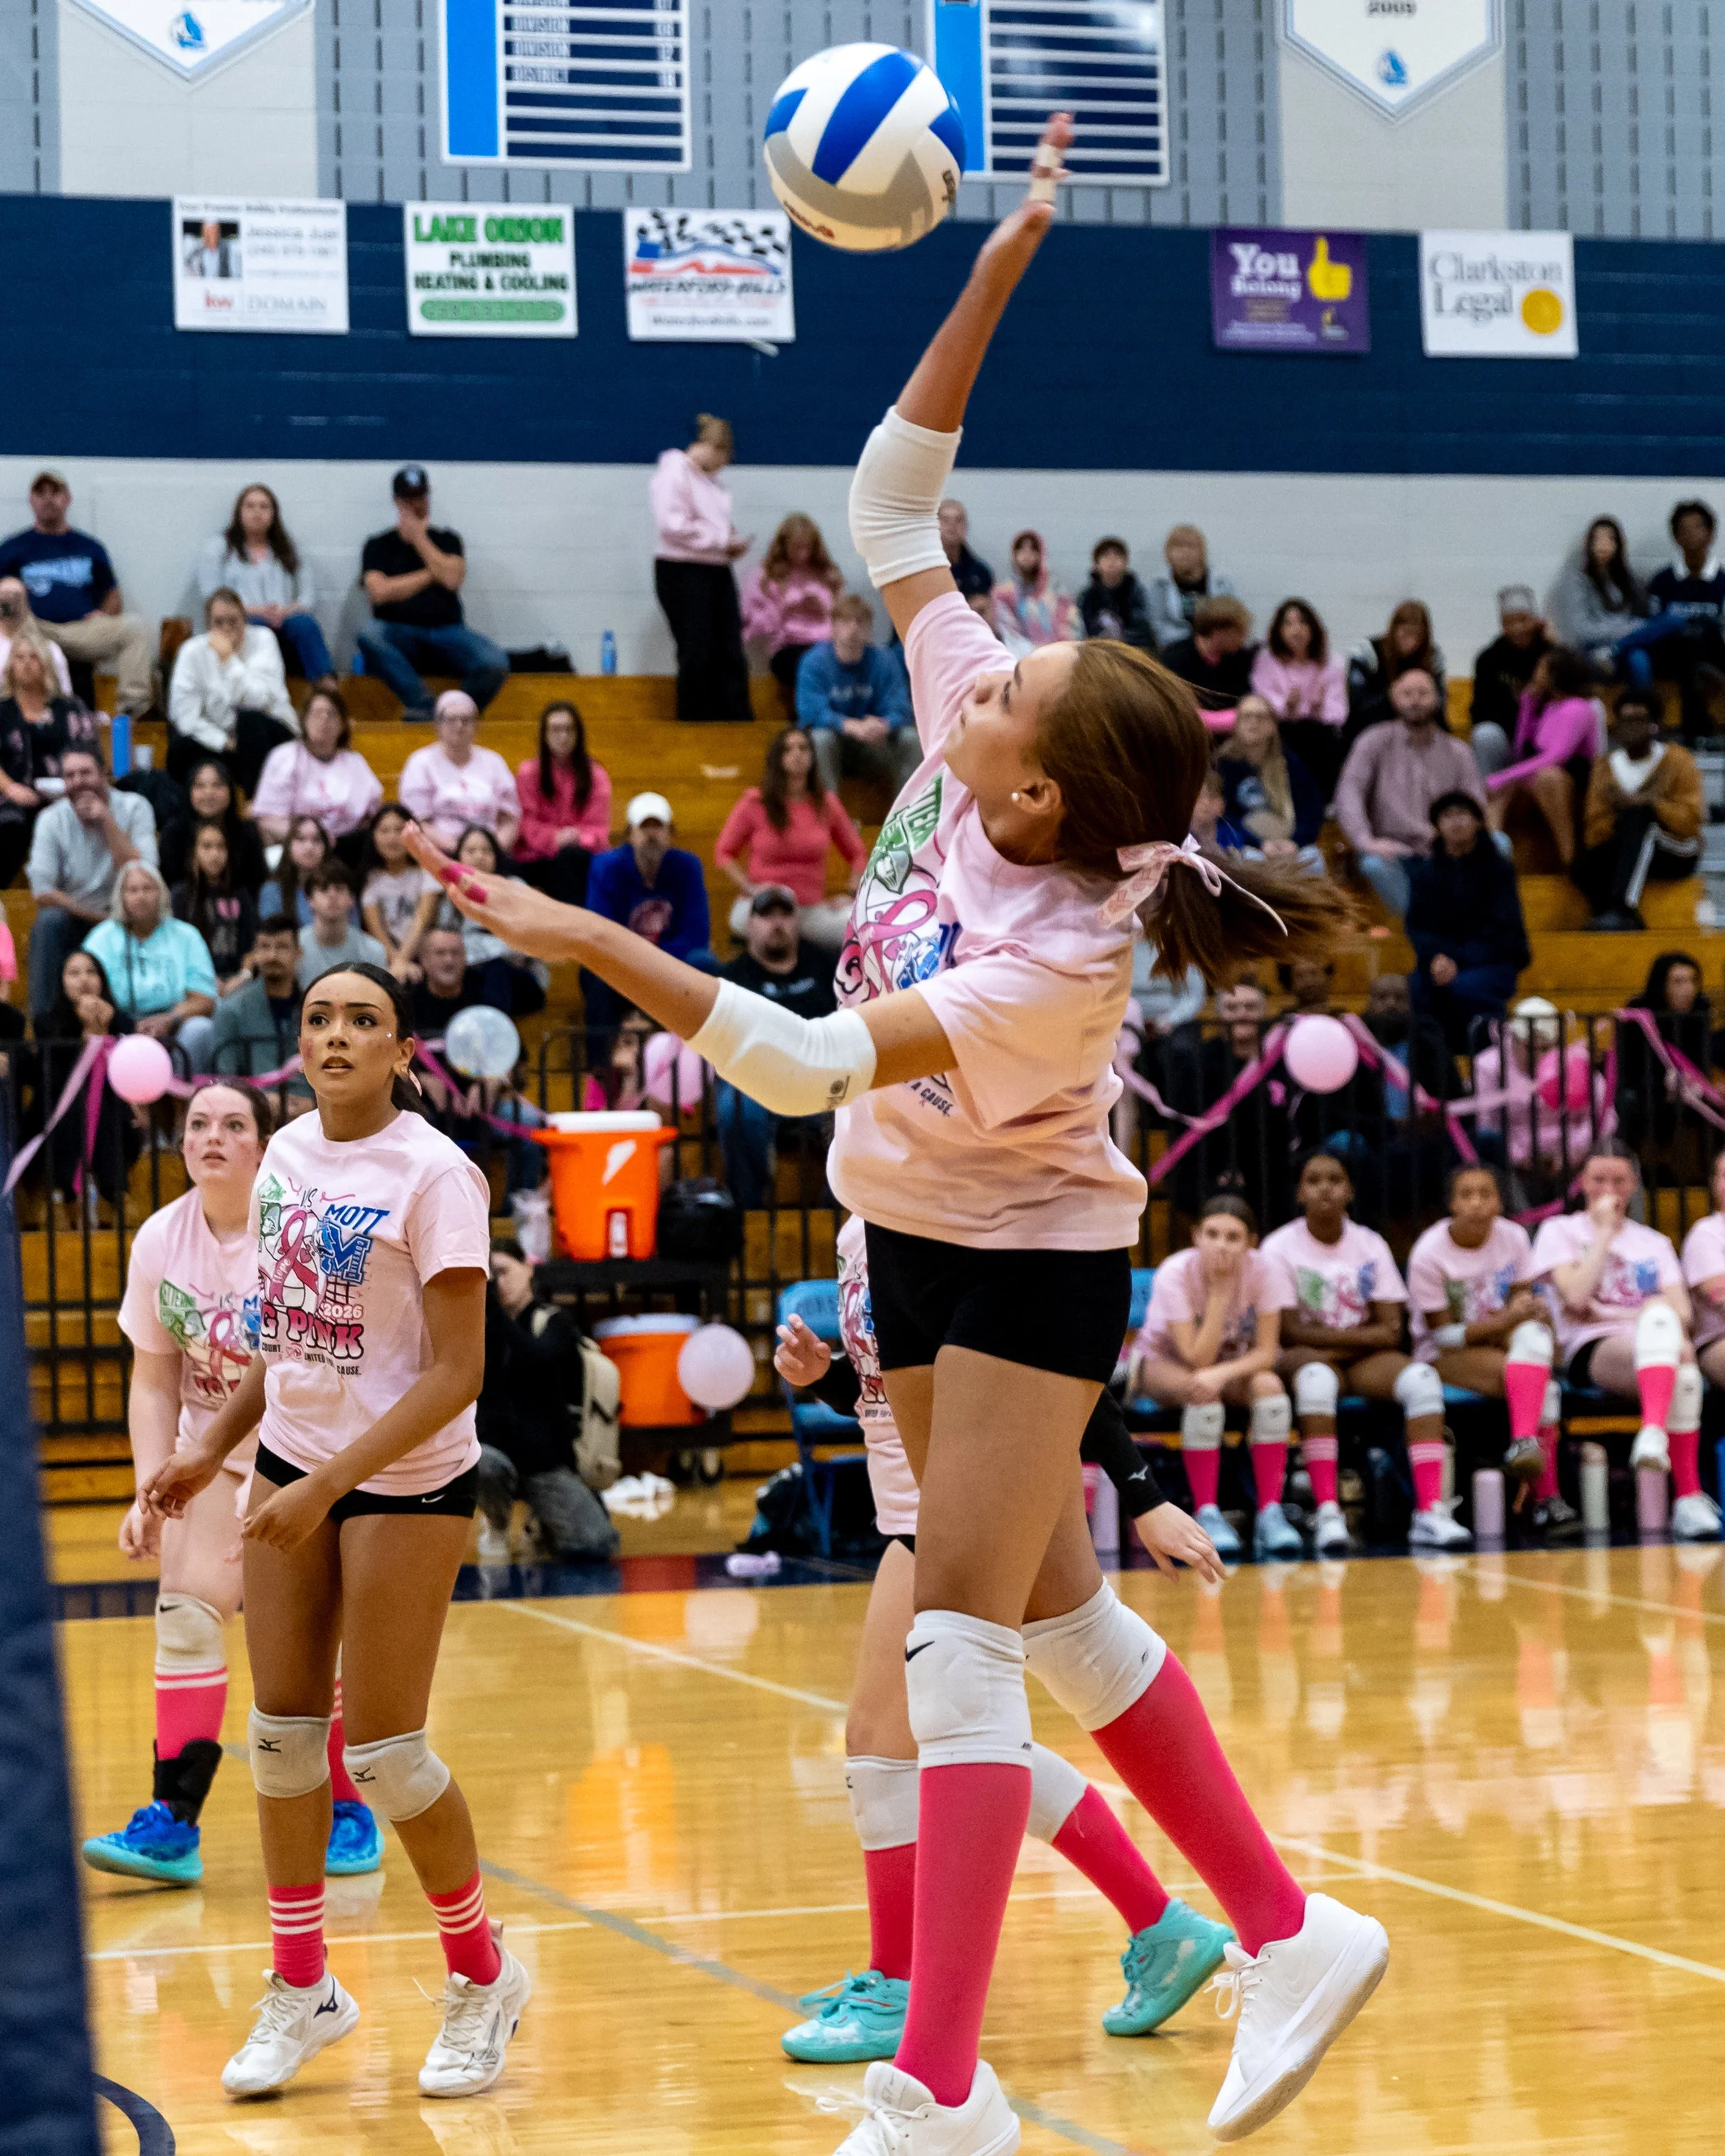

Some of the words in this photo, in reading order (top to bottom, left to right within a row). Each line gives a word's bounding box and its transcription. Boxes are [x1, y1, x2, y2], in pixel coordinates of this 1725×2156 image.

[415, 216, 477, 242] LAKE
[450, 252, 531, 268] PLUMBING
[1230, 243, 1301, 277] You
[1429, 252, 1564, 281] Clarkston
[415, 275, 478, 290] HEATING
[485, 276, 495, 290] &
[501, 276, 569, 291] COOLING
[1434, 282, 1514, 326] Legal
[324, 1204, 391, 1235] MOTT
[323, 1303, 364, 1321] 2026
[286, 1306, 364, 1360] PINK
[336, 1365, 362, 1376] CAUSE.
